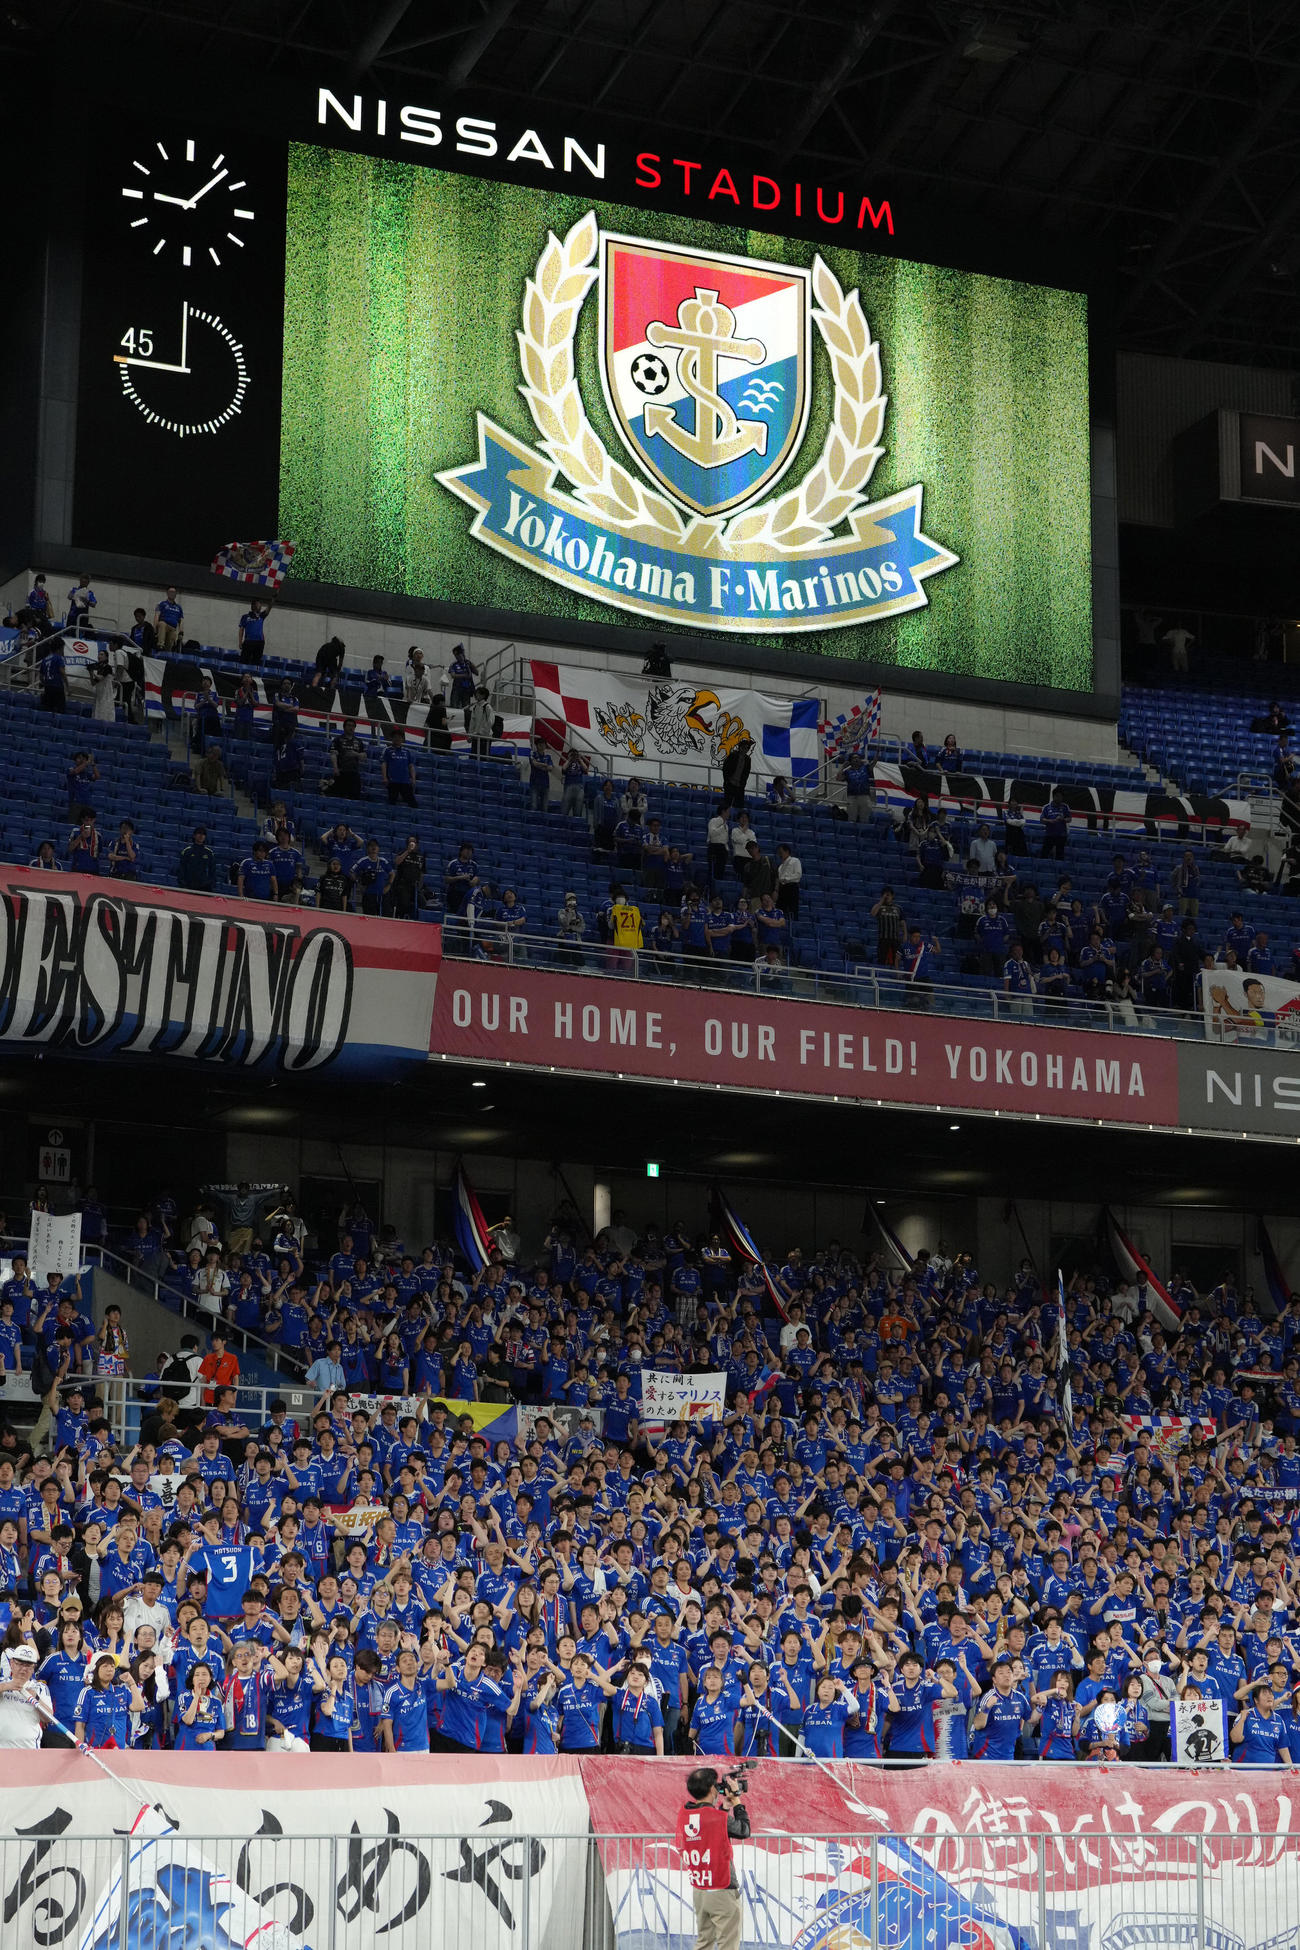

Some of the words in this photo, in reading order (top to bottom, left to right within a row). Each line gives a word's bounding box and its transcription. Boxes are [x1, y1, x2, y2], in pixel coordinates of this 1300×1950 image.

[318, 87, 606, 179] NISSAN
[635, 152, 895, 235] STADIUM
[120, 328, 154, 357] 45
[503, 488, 698, 603] Yokohama
[620, 911, 637, 929] 21
[0, 890, 354, 1072] ESTINO
[452, 989, 529, 1034] OUR
[554, 1001, 677, 1057] HOME,
[704, 1018, 776, 1062] OUR
[799, 1029, 918, 1076] FIELD!
[944, 1044, 1145, 1097] YOKOHAMA
[645, 1385, 722, 1402] 愛するマリノス
[646, 1406, 677, 1416] のため
[315, 1540, 324, 1553] 6
[221, 1555, 239, 1583] 3
[1215, 1665, 1241, 1678] NISSAN
[1178, 1700, 1220, 1714] 永戸勝也
[245, 1713, 257, 1729] 18
[993, 1714, 1022, 1722] NISSAN
[1250, 1728, 1280, 1740] NISSAN
[1200, 1737, 1209, 1752] 2
[3, 1799, 549, 1947] るらめや
